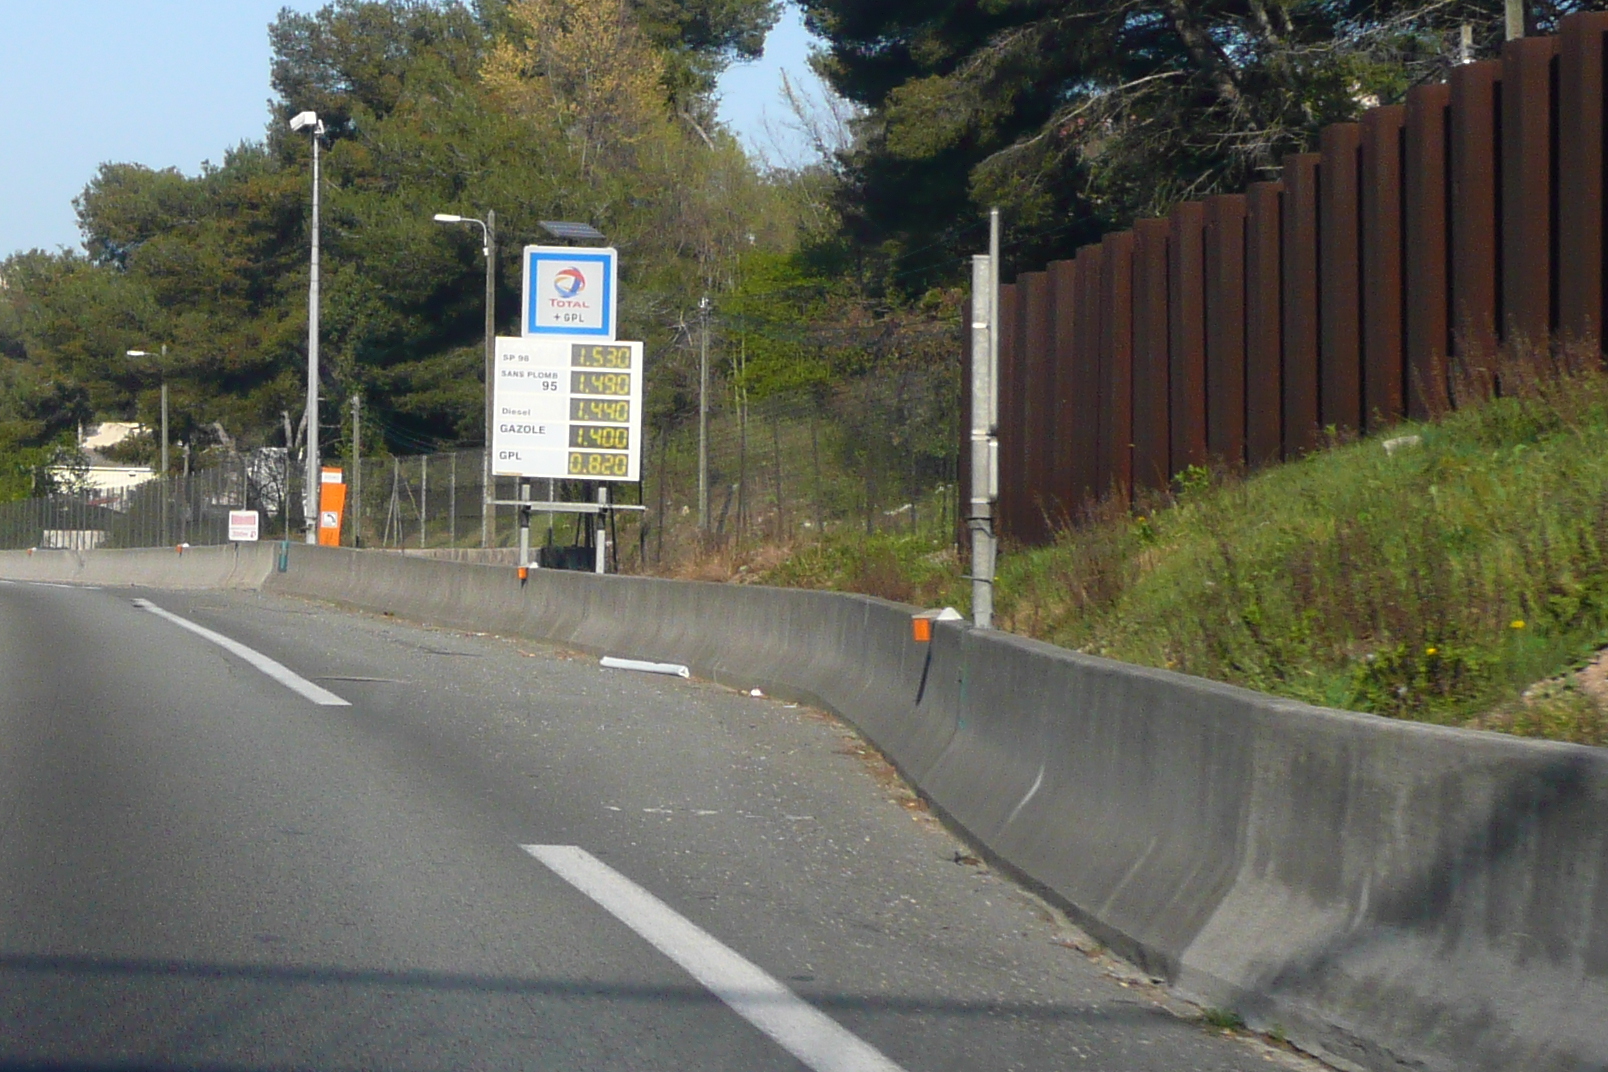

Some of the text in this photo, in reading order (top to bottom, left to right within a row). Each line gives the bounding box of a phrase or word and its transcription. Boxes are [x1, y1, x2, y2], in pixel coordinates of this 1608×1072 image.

[549, 298, 590, 308] TOTAL
[564, 313, 584, 322] GPL
[502, 354, 515, 362] SP
[579, 346, 630, 368] 1.530
[501, 370, 558, 379] SANS PLOMB
[542, 381, 558, 391] 95
[579, 374, 630, 395] 1.490
[502, 407, 531, 416] Diesel
[578, 401, 629, 421] 1.440
[500, 424, 546, 435] GAZOLE
[577, 427, 628, 448] 1.400
[499, 451, 522, 461] GPL
[569, 452, 627, 474] 0.820
